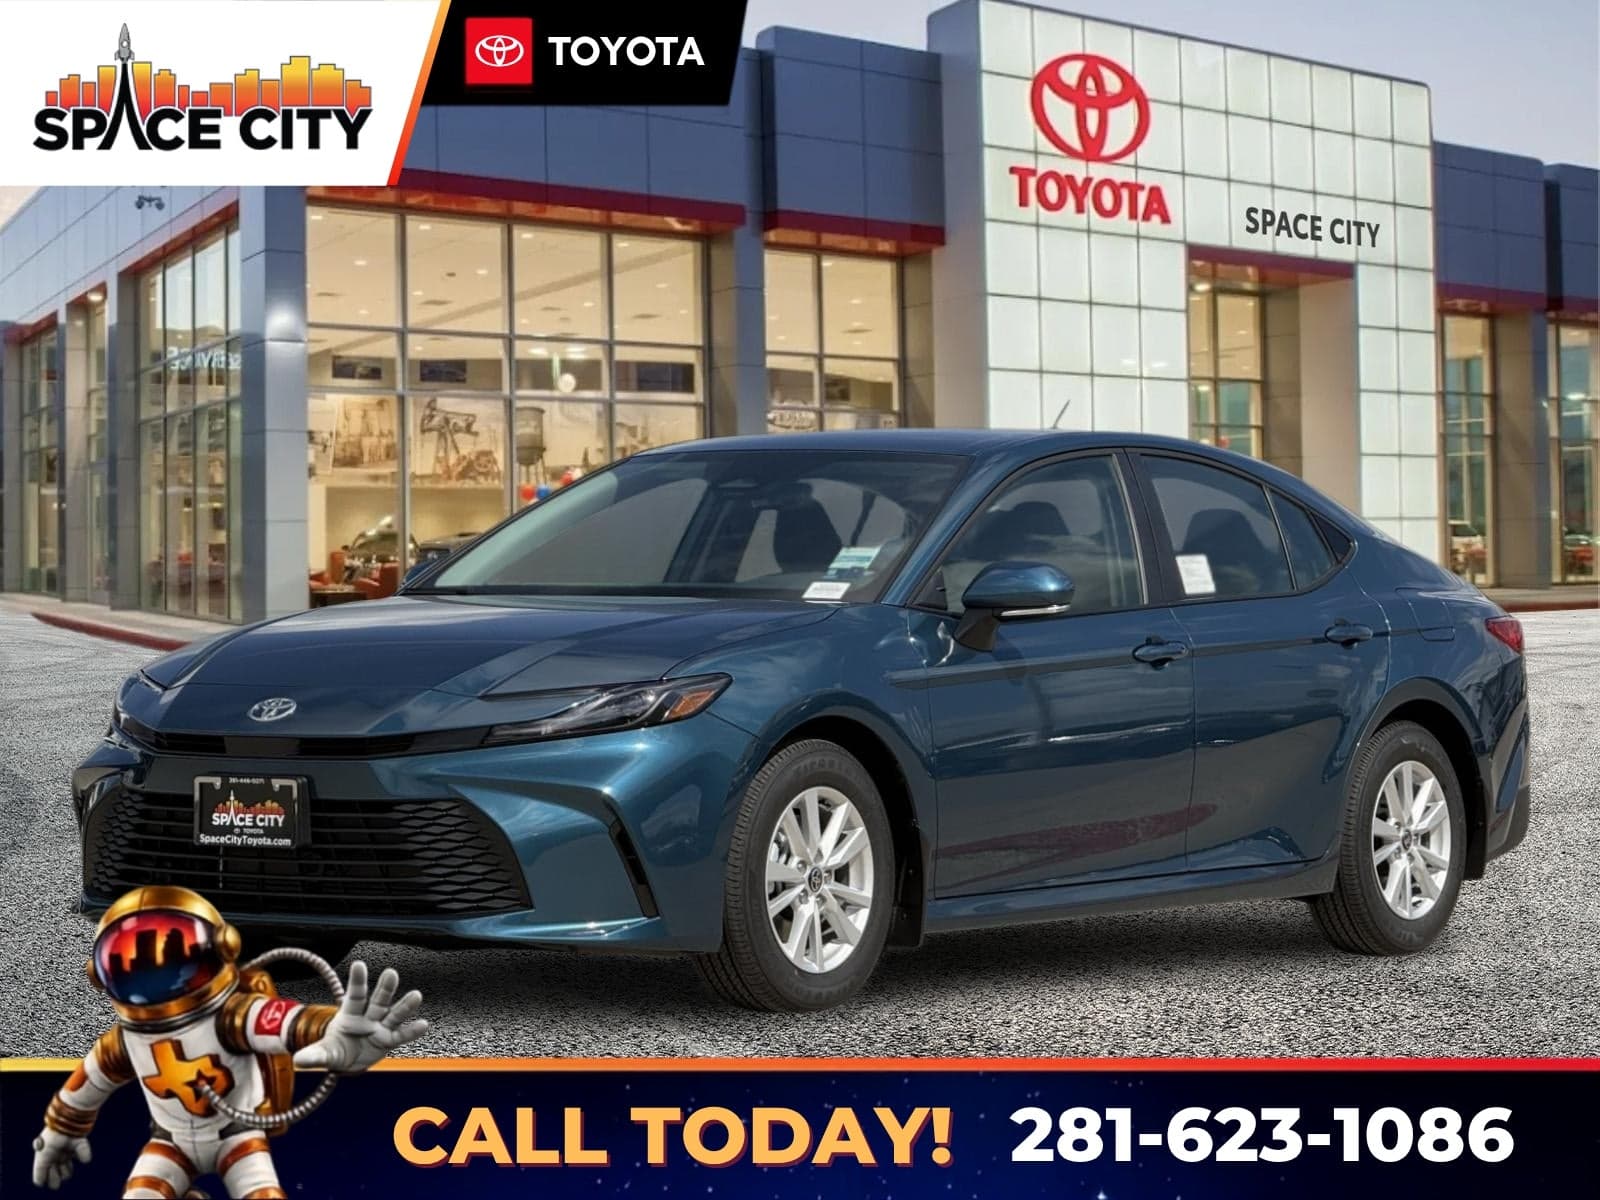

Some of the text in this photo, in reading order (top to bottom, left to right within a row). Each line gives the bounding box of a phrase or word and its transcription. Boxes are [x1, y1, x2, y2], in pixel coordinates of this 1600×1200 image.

[1009, 166, 1171, 225] TOYOTA
[1245, 206, 1381, 249] SPACE CITY
[211, 812, 285, 828] SPACE CITY
[199, 834, 292, 846] SpaceCityToyota.com
